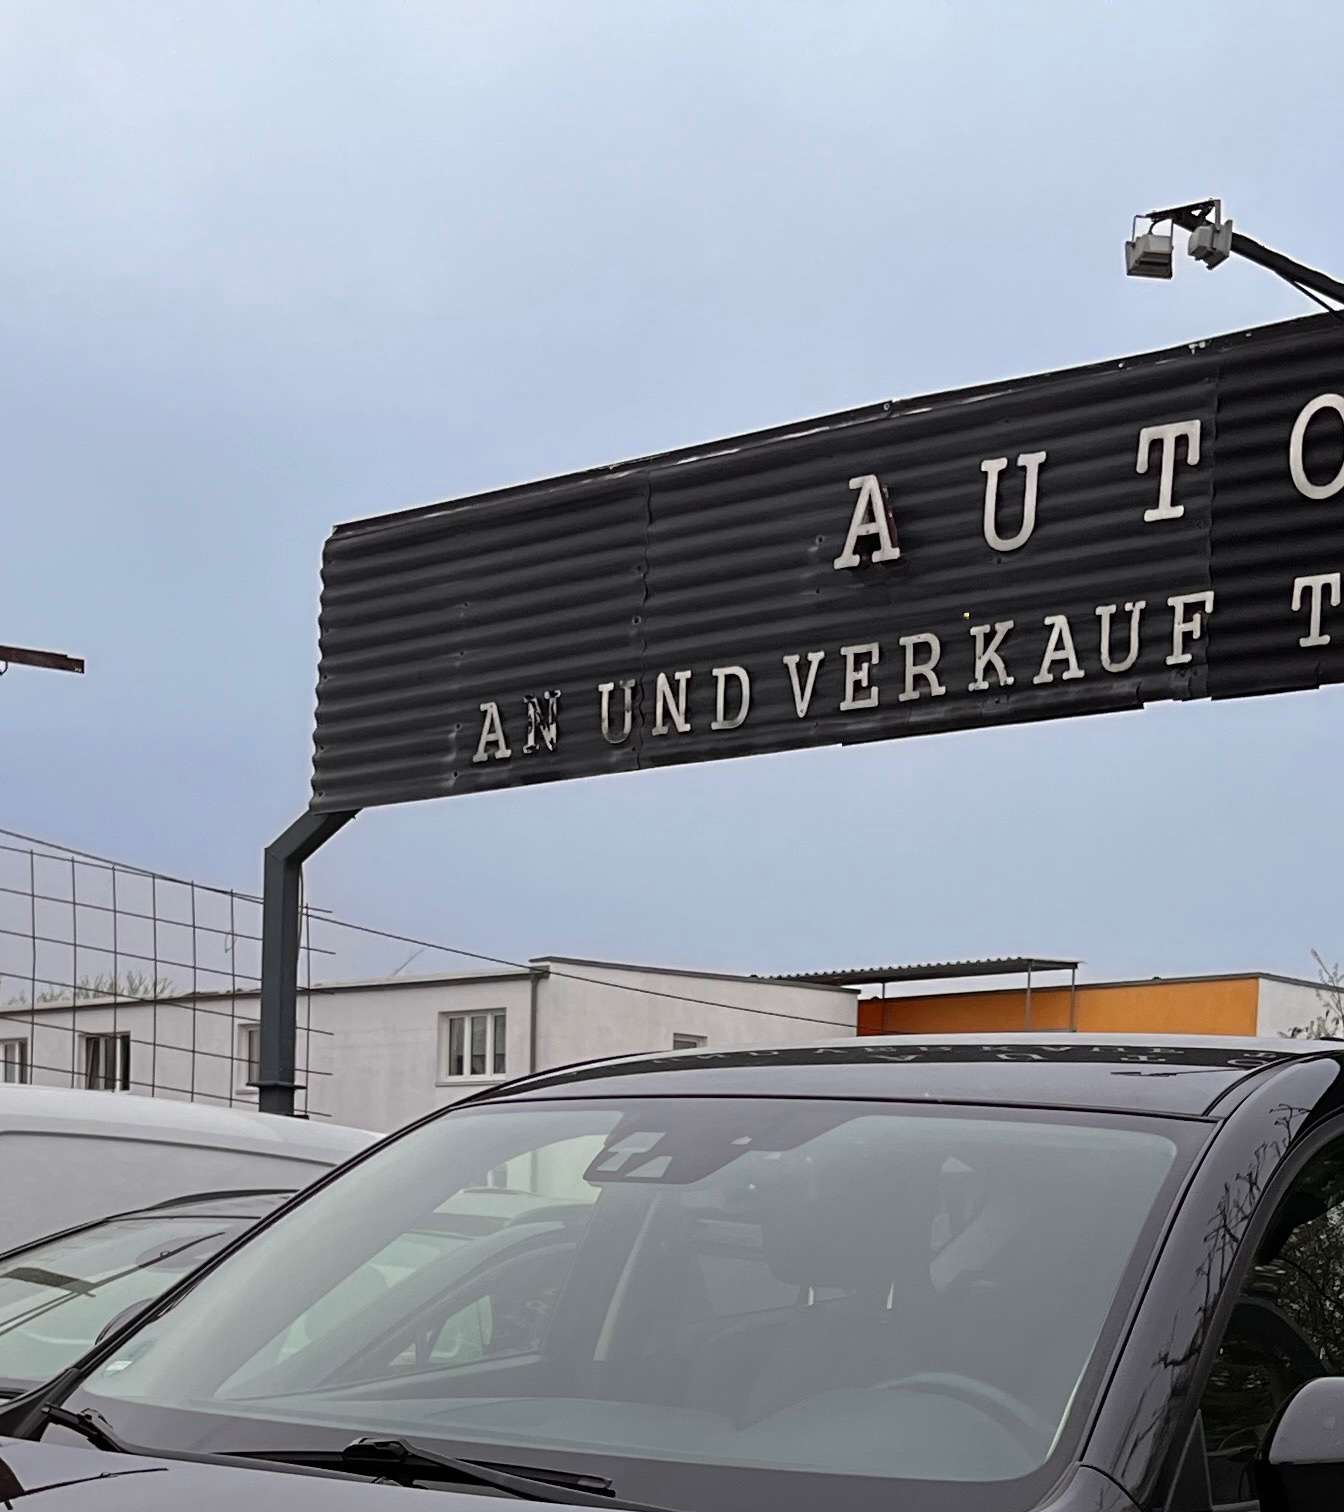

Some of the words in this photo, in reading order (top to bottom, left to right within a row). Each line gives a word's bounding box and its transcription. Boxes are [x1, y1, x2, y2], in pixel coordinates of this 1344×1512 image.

[472, 689, 561, 763] AN
[598, 666, 750, 745] UND
[782, 590, 1215, 718] VERKAUF
